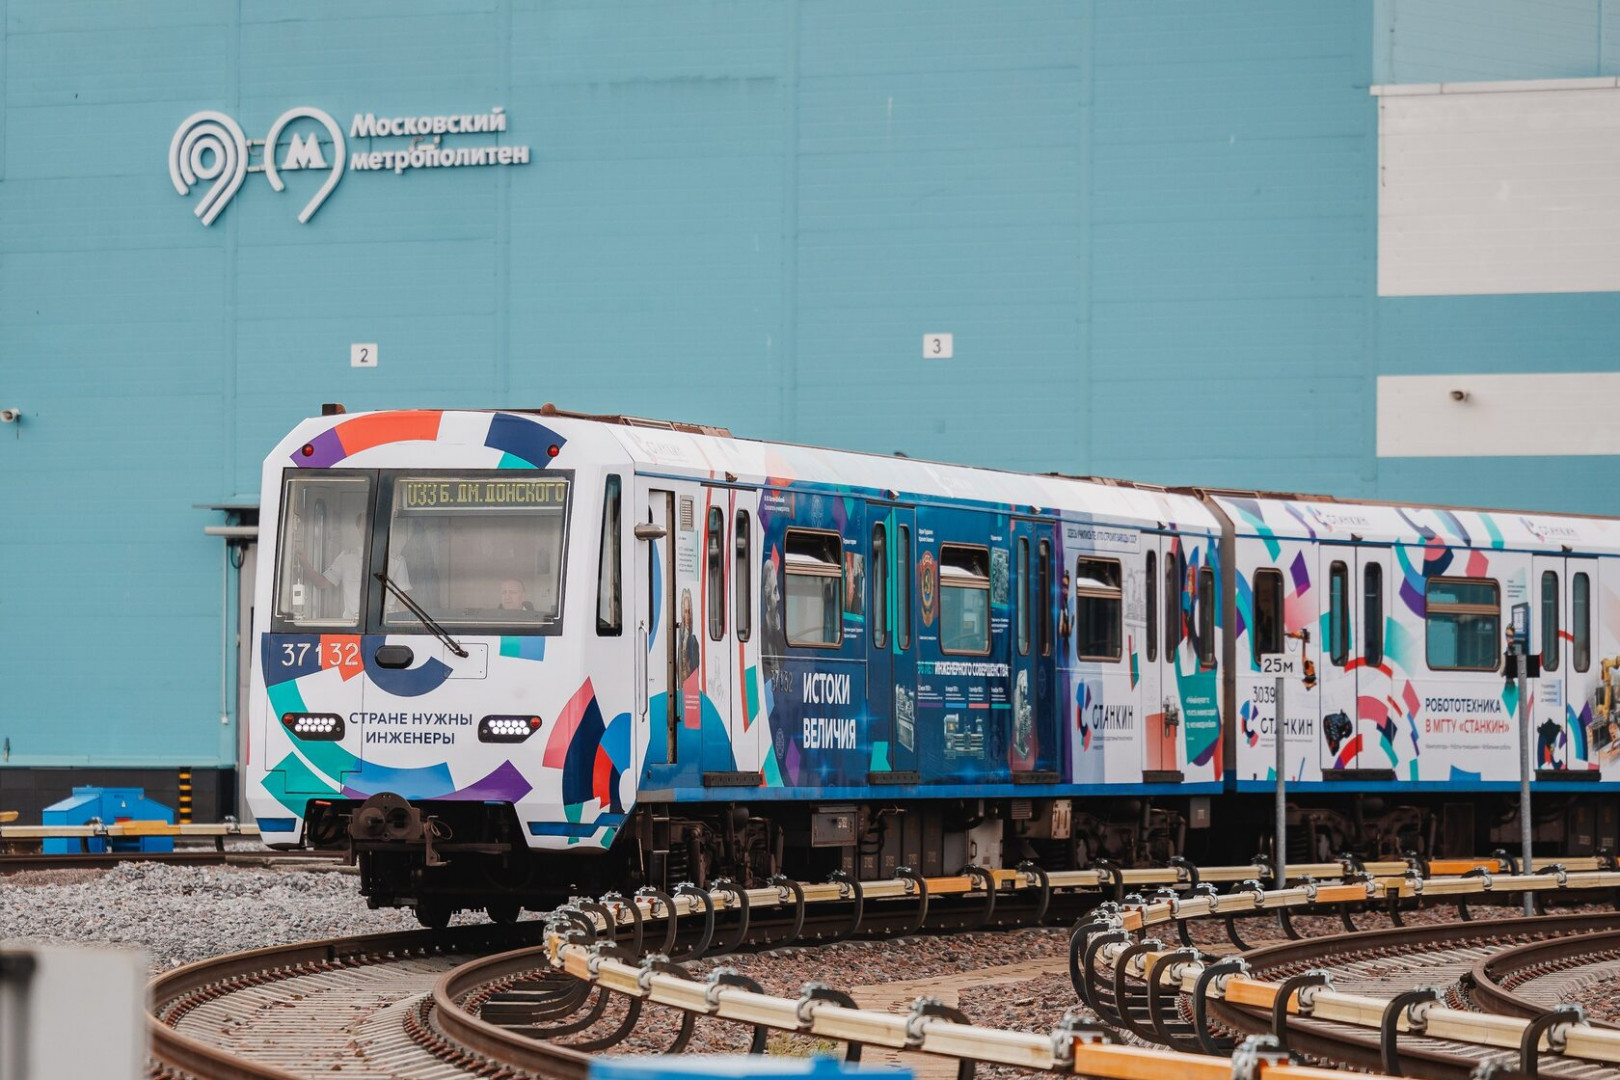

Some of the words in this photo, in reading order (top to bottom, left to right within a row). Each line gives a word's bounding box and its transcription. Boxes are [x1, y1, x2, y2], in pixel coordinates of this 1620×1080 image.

[350, 107, 507, 138] Московский
[350, 145, 531, 175] метрополитен
[360, 348, 369, 363] 2
[932, 338, 942, 354] 3
[281, 642, 359, 667] 37132
[803, 672, 850, 705] ИСТОКИ
[1425, 697, 1501, 714] РОБОТОТЕХНИКА
[349, 712, 408, 726] СТРАНЕ
[412, 713, 472, 726] НУЖНЫ
[1092, 704, 1133, 730] СТАНКИН
[1261, 717, 1314, 736] СТНКИН
[1425, 719, 1431, 733] В
[1434, 719, 1457, 734] МГТУ
[366, 732, 455, 745] ИНЖЕНЕРЫ
[803, 717, 857, 750] ВЕЛИЧИЯ
